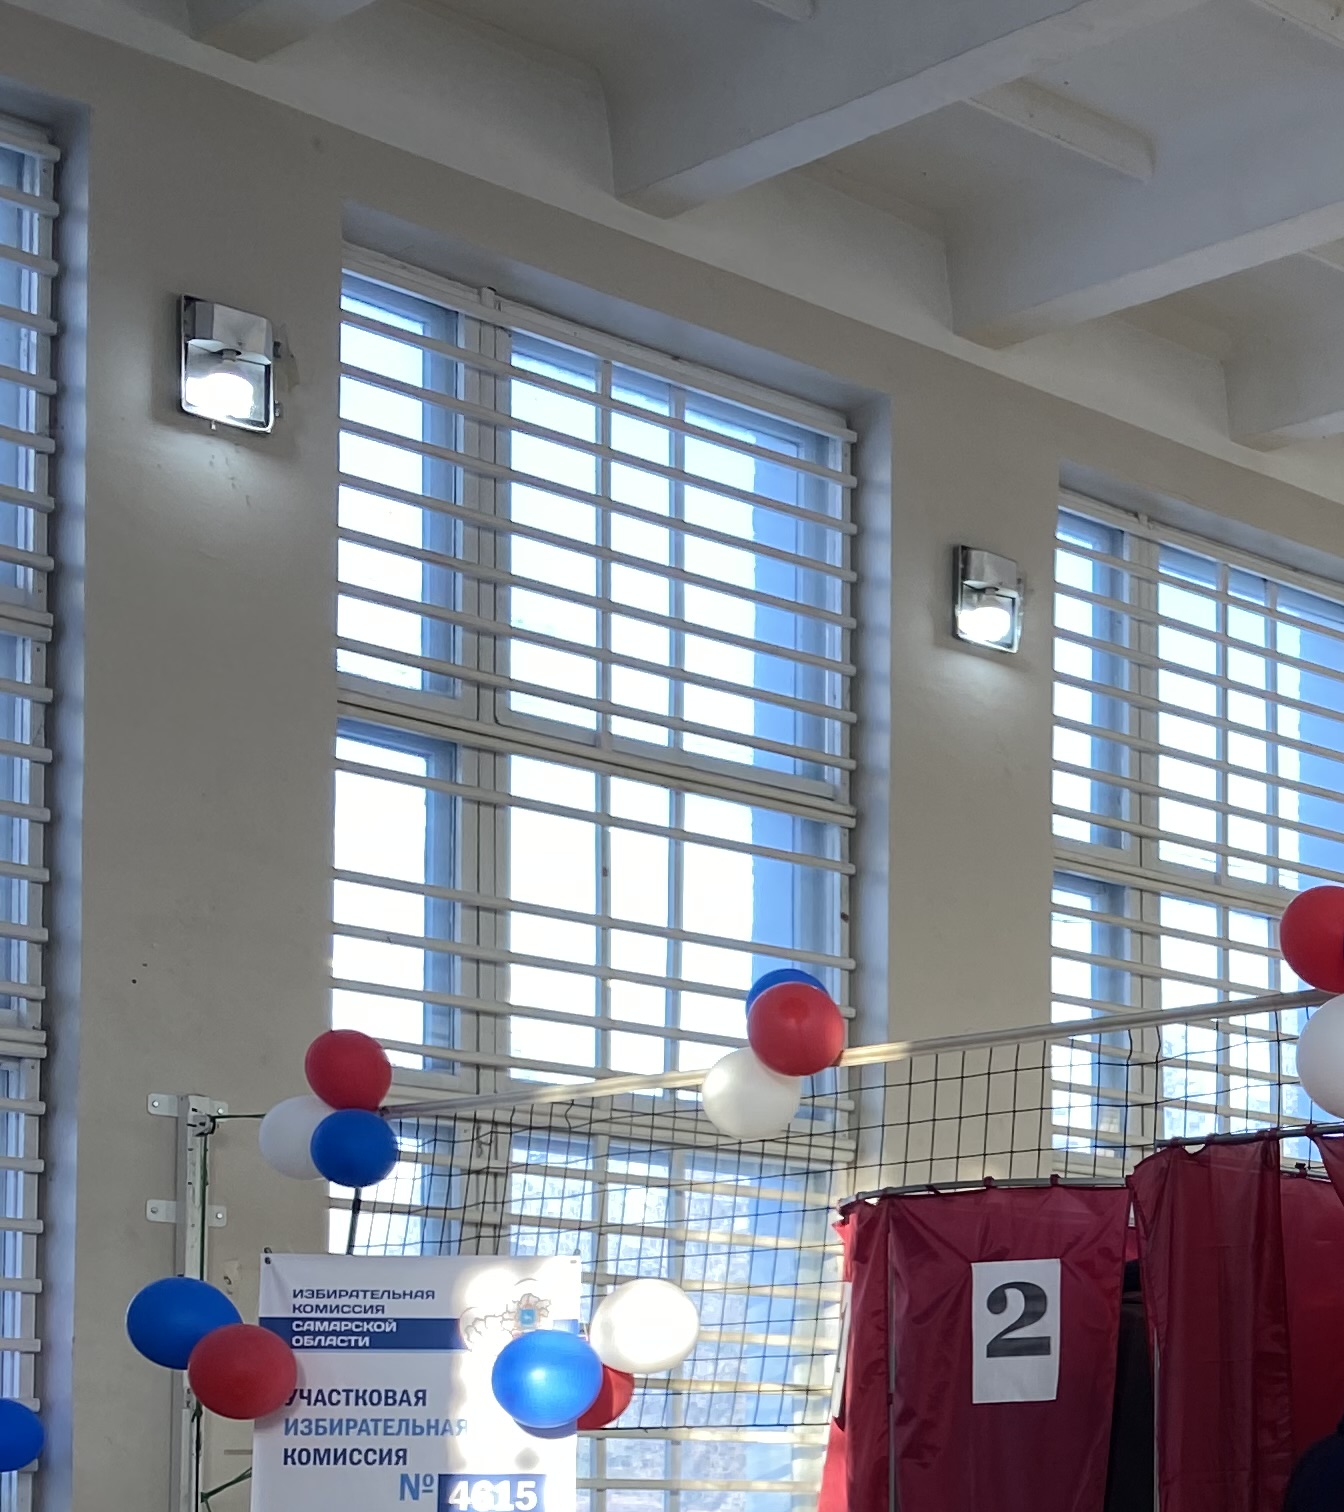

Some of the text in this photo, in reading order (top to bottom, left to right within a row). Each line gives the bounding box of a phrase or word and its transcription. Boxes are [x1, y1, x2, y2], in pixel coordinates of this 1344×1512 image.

[292, 1289, 436, 1300] ИЗБИРАТЕЛЬНАЯ
[292, 1304, 385, 1315] КОМИССИЯ
[291, 1319, 397, 1332] САМАРСКОЙ
[986, 1281, 1052, 1358] 2
[291, 1336, 370, 1347] ОБЛАСТИ
[284, 1418, 467, 1437] ИЗБИРАТЕЛЬНАЯ
[283, 1448, 407, 1466] КОМИССИЯ
[400, 1473, 538, 1512] № 4615
